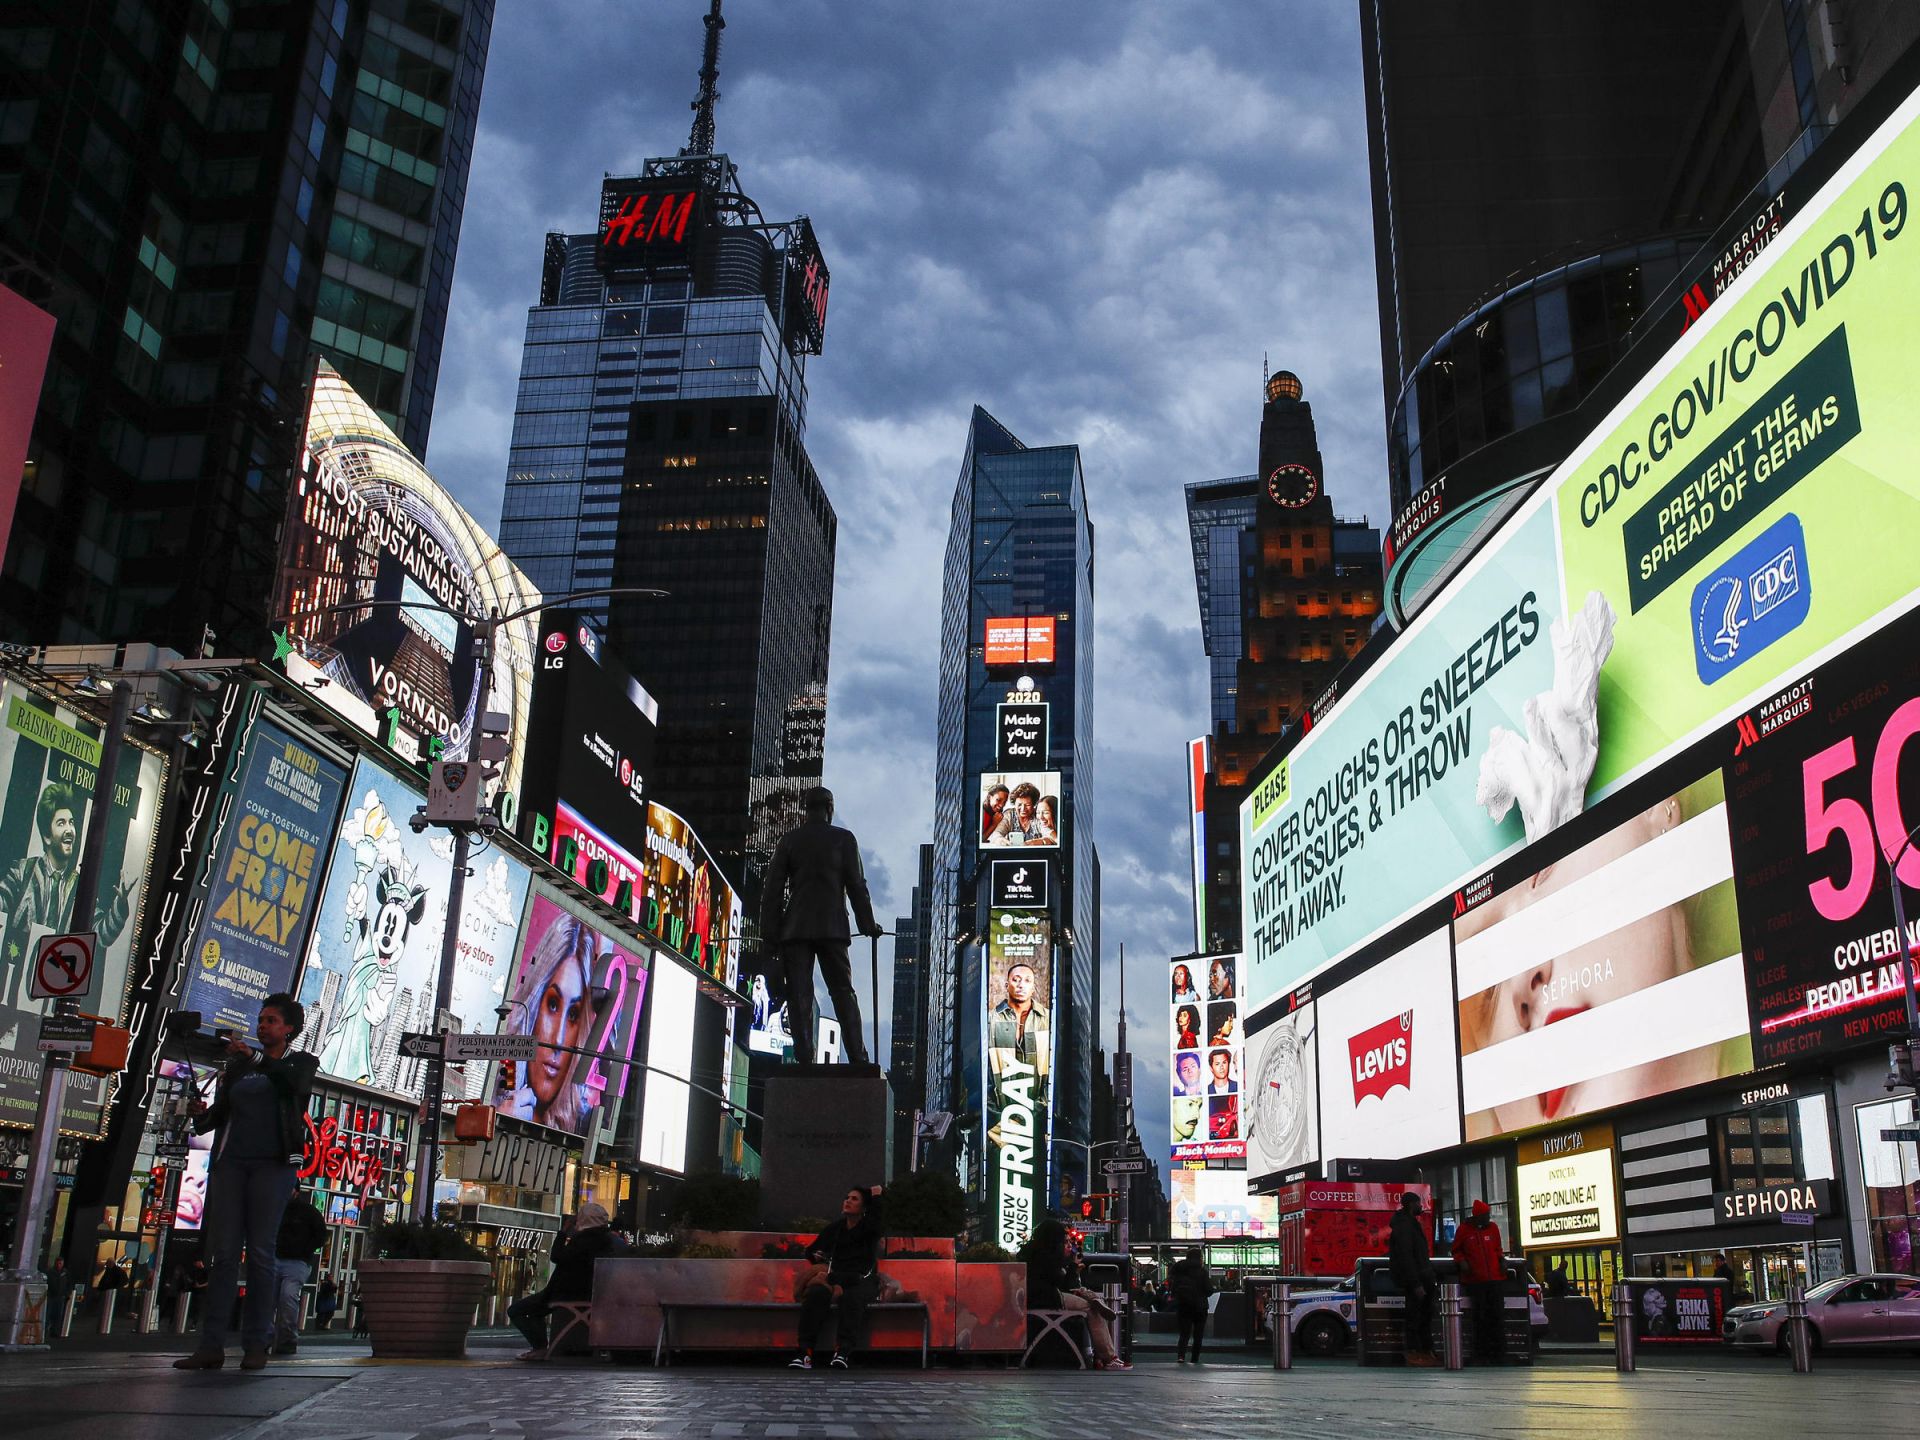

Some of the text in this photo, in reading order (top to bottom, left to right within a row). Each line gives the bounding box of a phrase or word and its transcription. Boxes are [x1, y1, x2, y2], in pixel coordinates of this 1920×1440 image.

[604, 192, 696, 246] H&M
[1714, 191, 1785, 278] MARRIOTT
[1715, 222, 1779, 298] MARQUIS
[1581, 181, 1908, 528] CDC.GOV/COVID19
[1658, 394, 1797, 535] PREVENT THE
[315, 461, 367, 523] MOST
[1395, 476, 1446, 534] MARRIOTT
[1639, 396, 1839, 580] SPREAD OF GERMS
[387, 500, 417, 539] NEW
[419, 528, 448, 573] YORK
[1396, 500, 1440, 551] MARQUIS
[370, 510, 463, 611] SUSTAINABLE
[1754, 555, 1795, 603] CDC
[398, 609, 423, 640] PARTNER
[423, 629, 431, 646] OF
[430, 635, 440, 655] THE
[439, 643, 453, 665] YEAR
[544, 657, 564, 669] LG
[370, 656, 461, 745] VORNADO
[1006, 692, 1040, 703] 2020
[1760, 678, 1815, 719] MARRIOTT
[16, 707, 95, 763] RAISING SPIRITS
[1004, 713, 1041, 725] Make
[1762, 698, 1811, 736] MARQUIS
[1007, 728, 1038, 743] your
[1008, 743, 1036, 757] day.
[1253, 591, 1540, 882] COVER COUGHS OR SNEEZES
[60, 759, 74, 781] ON
[284, 742, 320, 778] WINNER!
[268, 756, 322, 803] BEST MUSICAL
[631, 770, 643, 795] LG
[1254, 767, 1286, 819] PLEASE
[246, 799, 320, 846] COME TOGETHER AT
[1253, 708, 1472, 924] WITH TISSUES, & THROW
[238, 815, 316, 880] COME
[647, 826, 681, 864] YouTube
[608, 855, 619, 877] TV
[532, 812, 720, 973] BROADWAY
[1007, 885, 1032, 893] TikTok
[1466, 873, 1494, 896] MARRIOTT
[1467, 887, 1492, 906] MARQUIS
[214, 887, 300, 945] AWAY
[1013, 916, 1040, 925] Spotify
[1254, 867, 1346, 964] THEM AWAY.
[211, 922, 290, 958] THE REMARKABLE TRUE STORY
[472, 946, 495, 967] store
[997, 934, 1042, 945] LECRAE
[225, 960, 270, 989] MASTERPIECE!
[237, 984, 245, 994] and
[245, 985, 259, 999] plenty
[1541, 957, 1615, 1005] SEPHORA
[1806, 971, 1873, 1014] PEOPLE
[63, 1026, 87, 1034] Square
[458, 1037, 534, 1046] PEDESTRIAN FLOW ZONE
[585, 955, 648, 1097] 21
[1844, 1008, 1906, 1039] NEW YORK
[410, 1040, 430, 1051] ONE
[1771, 1030, 1823, 1059] LAKE CITY
[1741, 1083, 1789, 1105] SEPHORA
[66, 1109, 99, 1122] & BROADWAY
[1000, 1055, 1034, 1195] FRIDAY
[1176, 1143, 1243, 1156] Black Monday
[1543, 1132, 1584, 1156] INVICTA
[477, 1131, 568, 1195] FOREVER
[1549, 1166, 1576, 1181] INVICTA
[1003, 1193, 1015, 1229] NEW
[1309, 1191, 1362, 1202] COFFEED
[1530, 1185, 1597, 1210] SHOP ONLINE AT
[1724, 1186, 1817, 1218] SEPHORA
[496, 1227, 543, 1249] FOREVER 21
[1532, 1213, 1599, 1233] INVICTASTORES.COM
[1676, 1299, 1710, 1315] ERIKA
[1677, 1316, 1710, 1331] JAYNE
